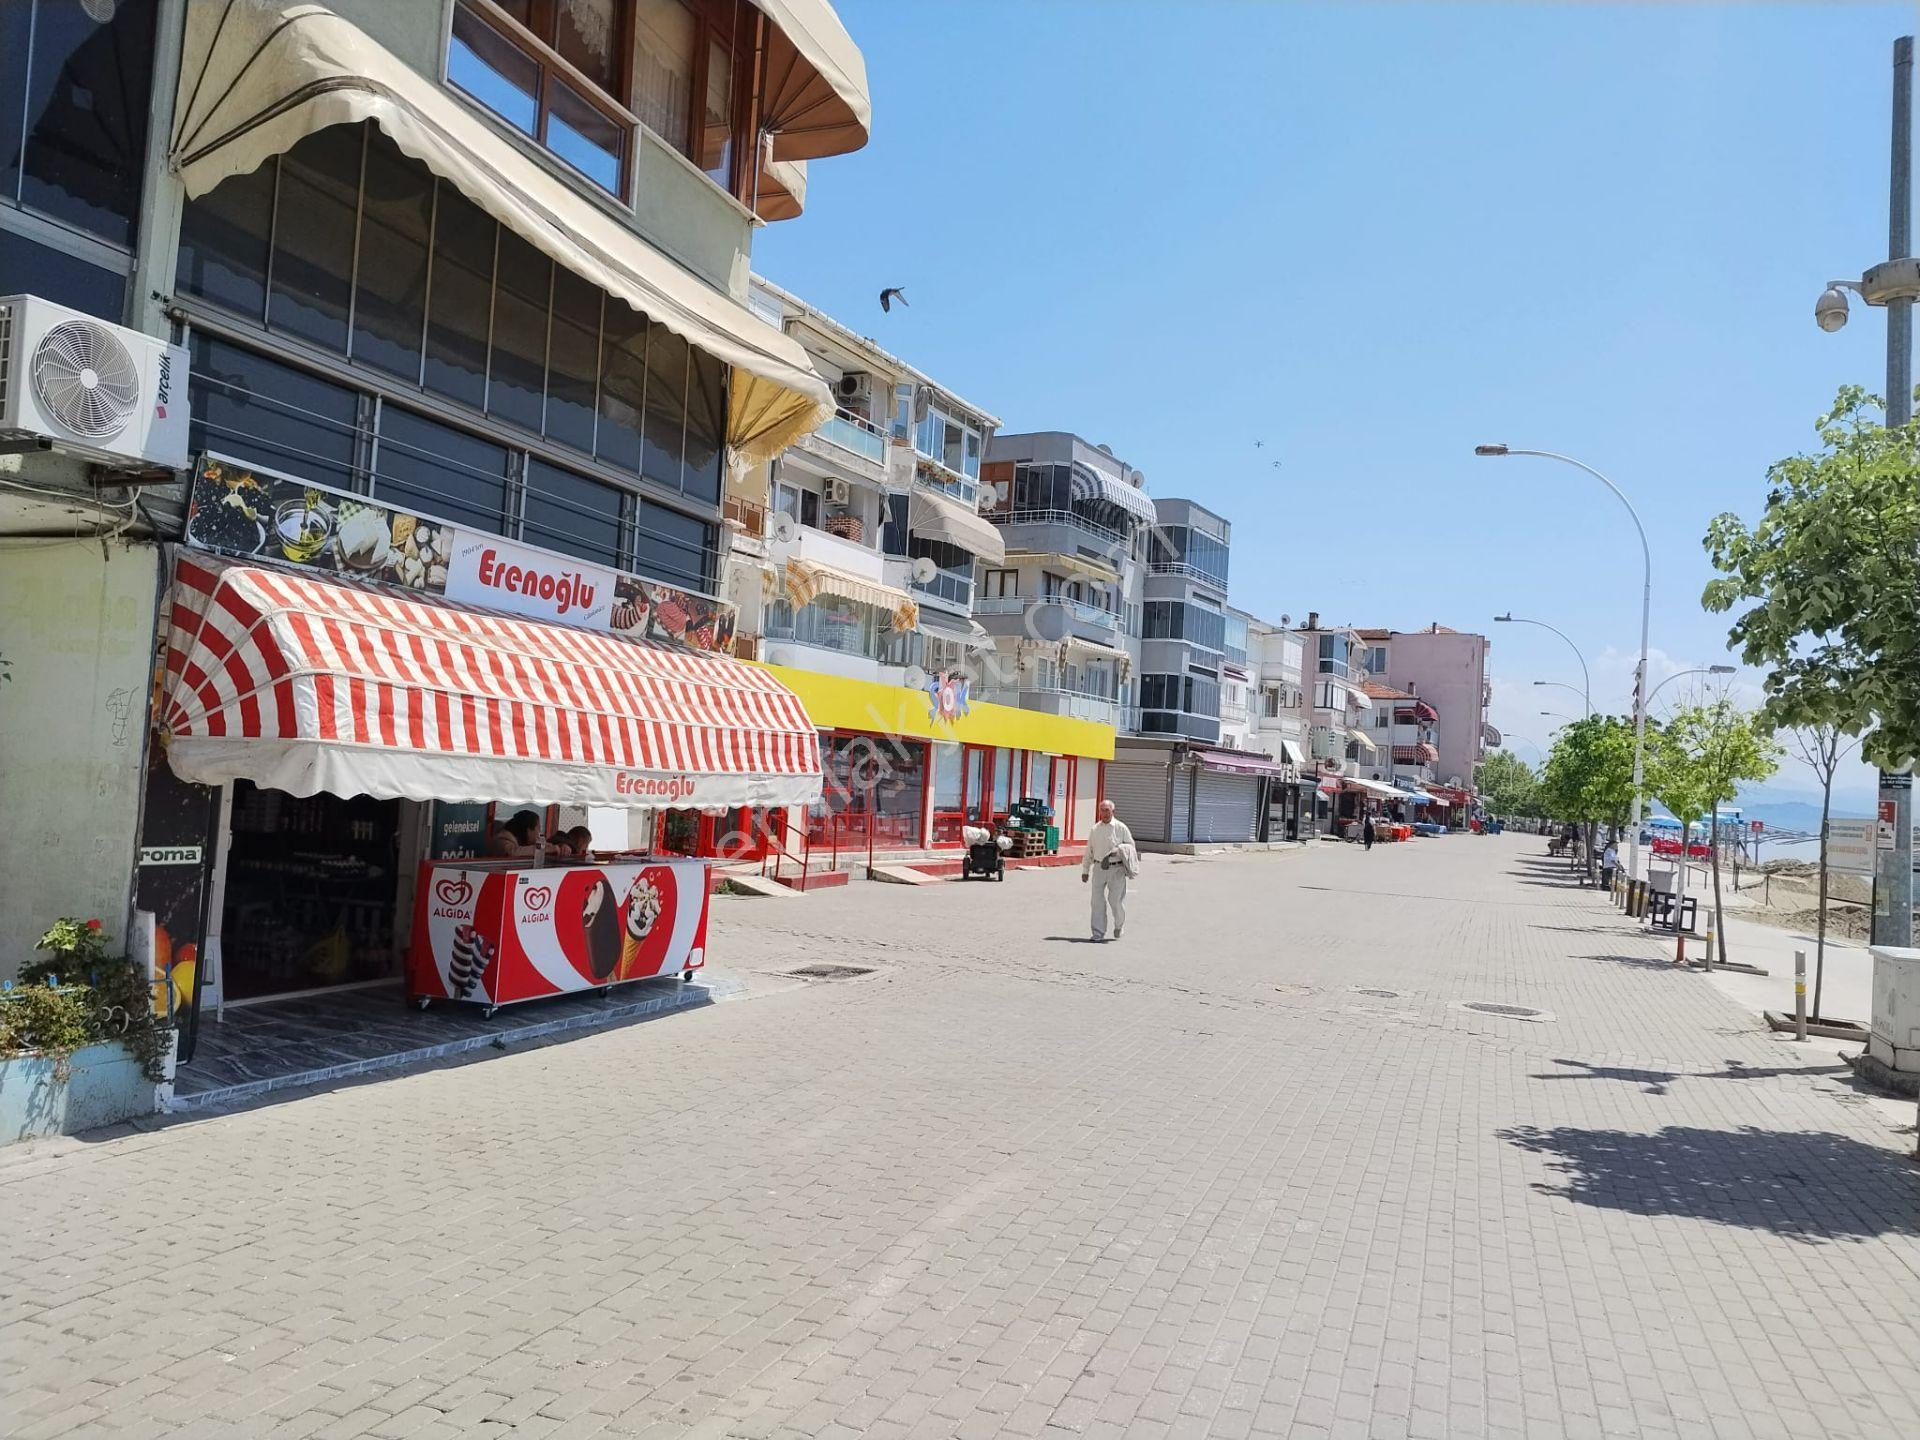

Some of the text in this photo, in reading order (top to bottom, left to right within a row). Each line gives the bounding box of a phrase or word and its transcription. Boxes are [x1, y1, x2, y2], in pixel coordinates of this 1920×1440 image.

[158, 352, 172, 404] arçelik
[478, 549, 595, 614] Erenoğlu
[616, 771, 695, 802] Erenoğlu
[443, 819, 480, 836] geleneksel
